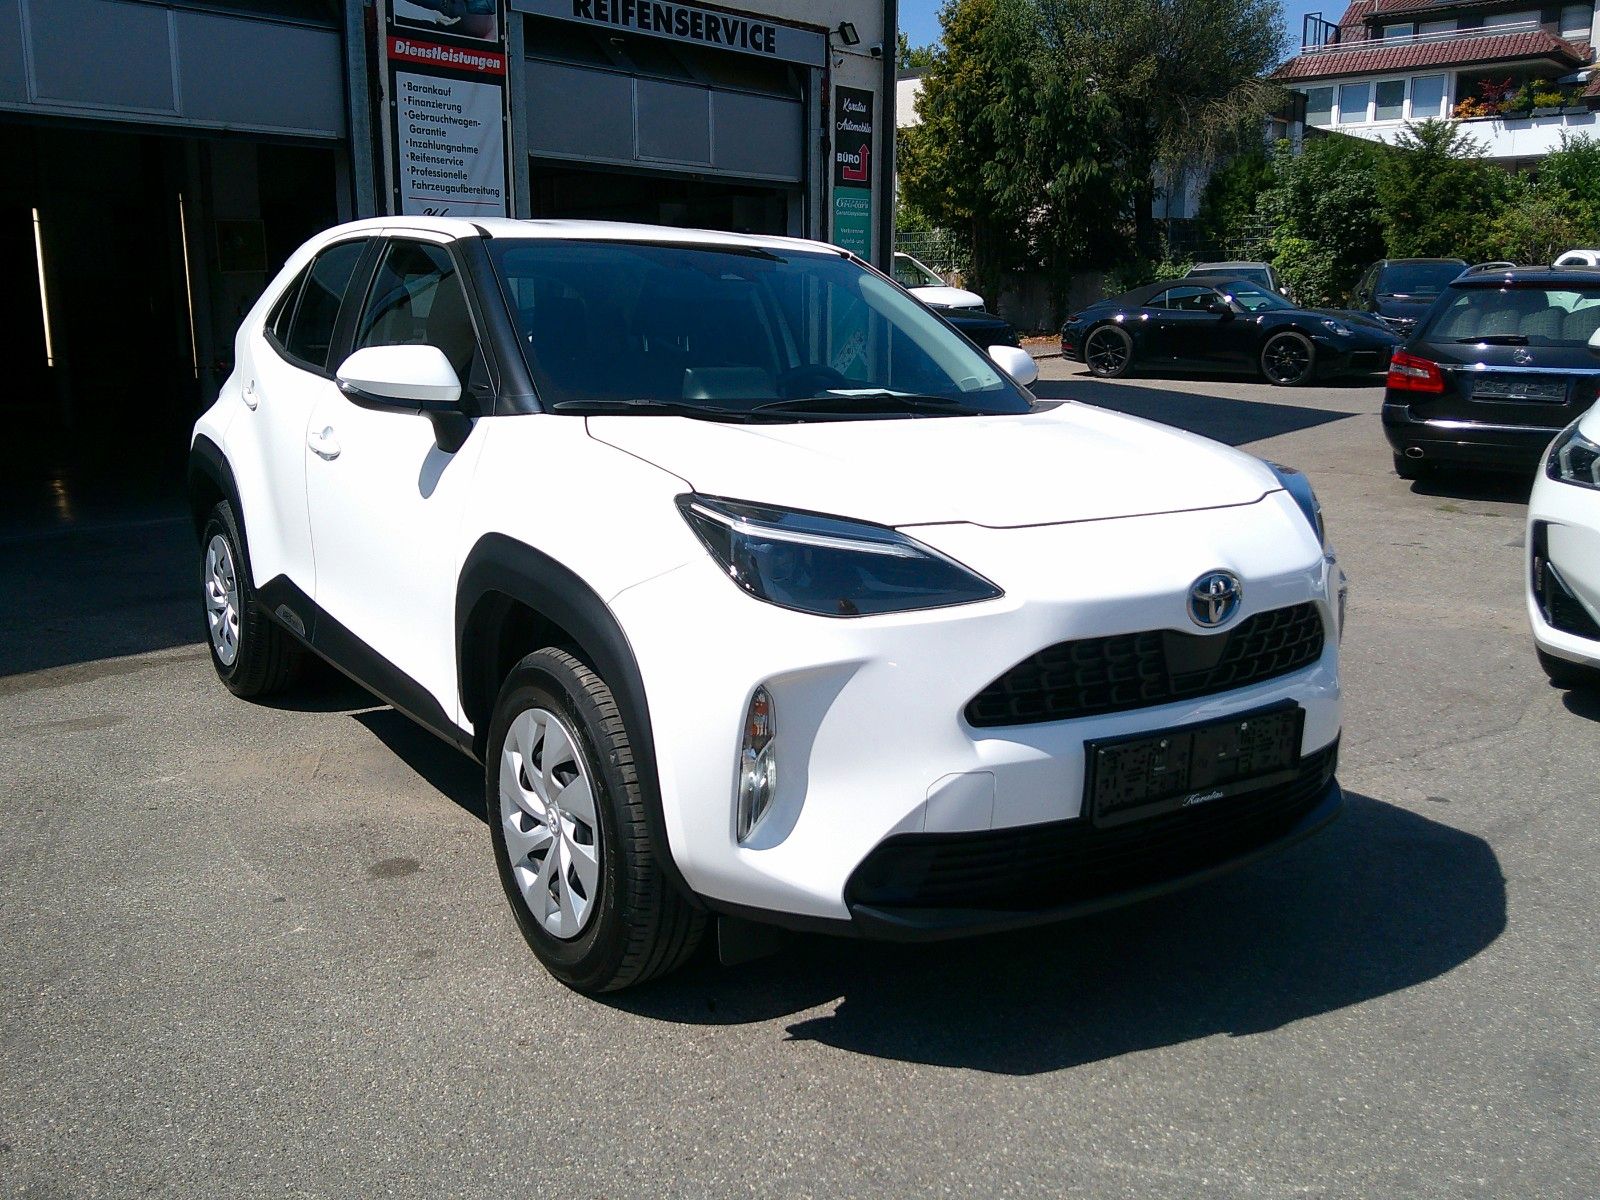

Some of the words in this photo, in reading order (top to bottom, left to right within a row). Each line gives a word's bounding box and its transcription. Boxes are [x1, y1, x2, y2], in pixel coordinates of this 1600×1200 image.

[572, 0, 776, 53] REIFENSERVICE
[395, 40, 501, 70] Dienstleistungen
[407, 82, 451, 97] Barankauf
[407, 96, 462, 114] Finanzierung
[408, 110, 481, 128] Gebrauchtwagen-
[409, 124, 447, 138] Garantie
[409, 139, 479, 155] Inzahlungnahme
[410, 152, 464, 167] Reifenservice
[836, 151, 860, 165] BÜRO
[410, 166, 468, 181] Professionelle
[411, 180, 500, 198] Fahrzeugaufbereitung
